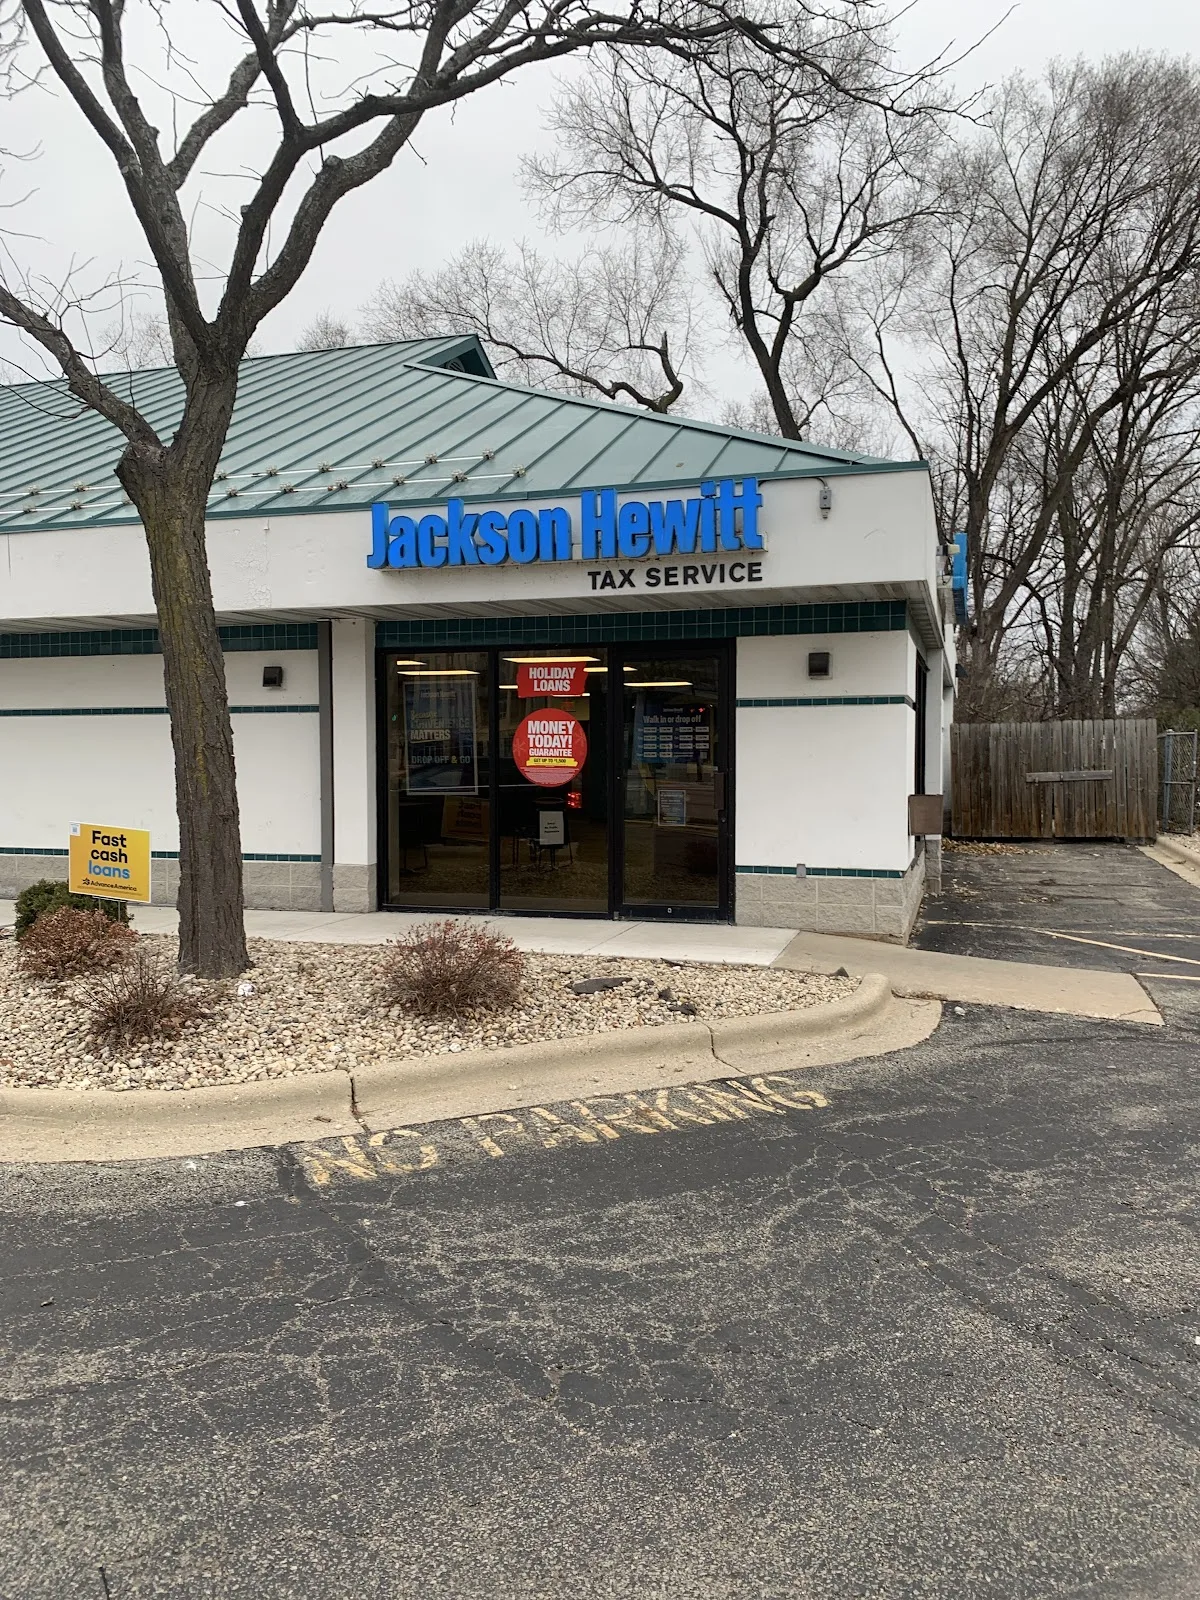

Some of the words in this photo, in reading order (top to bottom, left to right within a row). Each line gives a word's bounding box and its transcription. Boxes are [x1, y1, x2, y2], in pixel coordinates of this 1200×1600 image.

[367, 498, 573, 569] Jackson
[581, 476, 764, 561] Hewitt
[587, 569, 636, 590] TAX
[645, 561, 763, 587] SERVICE
[528, 667, 576, 679] HOLIDAY
[533, 680, 571, 691] LOANS
[643, 715, 660, 723] Walk
[661, 715, 667, 723] in
[675, 715, 690, 725] drop
[410, 729, 451, 740] MATTERS
[527, 720, 576, 735] MONEY
[527, 735, 573, 748] TODAY!
[411, 755, 432, 764] DROP
[434, 755, 450, 764] OFF
[451, 755, 458, 764] &
[460, 755, 471, 764] GO
[528, 748, 573, 757] GUARANTEE
[91, 830, 127, 848] Fast
[90, 848, 128, 864] cash
[88, 860, 130, 879] loans
[303, 1129, 438, 1185] NO
